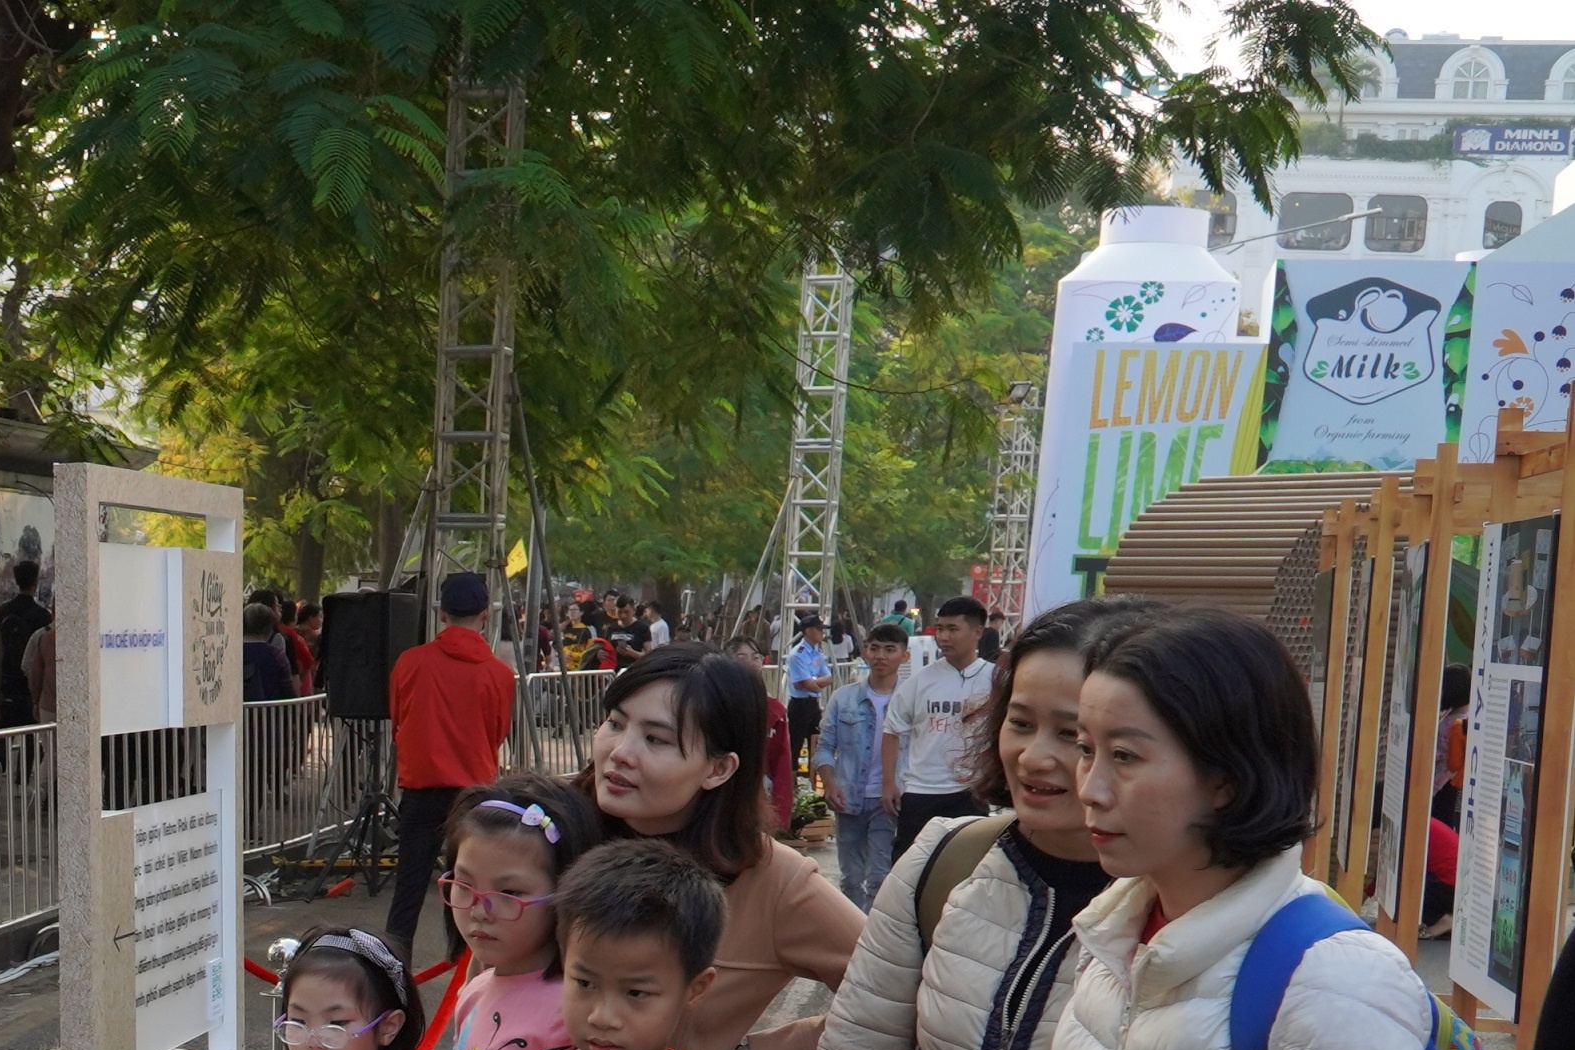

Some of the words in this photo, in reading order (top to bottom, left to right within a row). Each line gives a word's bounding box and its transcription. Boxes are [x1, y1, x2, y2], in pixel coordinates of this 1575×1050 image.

[1504, 129, 1559, 140] MINH
[1495, 141, 1565, 152] DIAMOND
[1330, 352, 1400, 380] Milk
[1089, 348, 1243, 430] LEMON
[1345, 412, 1375, 428] from
[1313, 424, 1363, 444] Organic
[1361, 430, 1411, 445] farming
